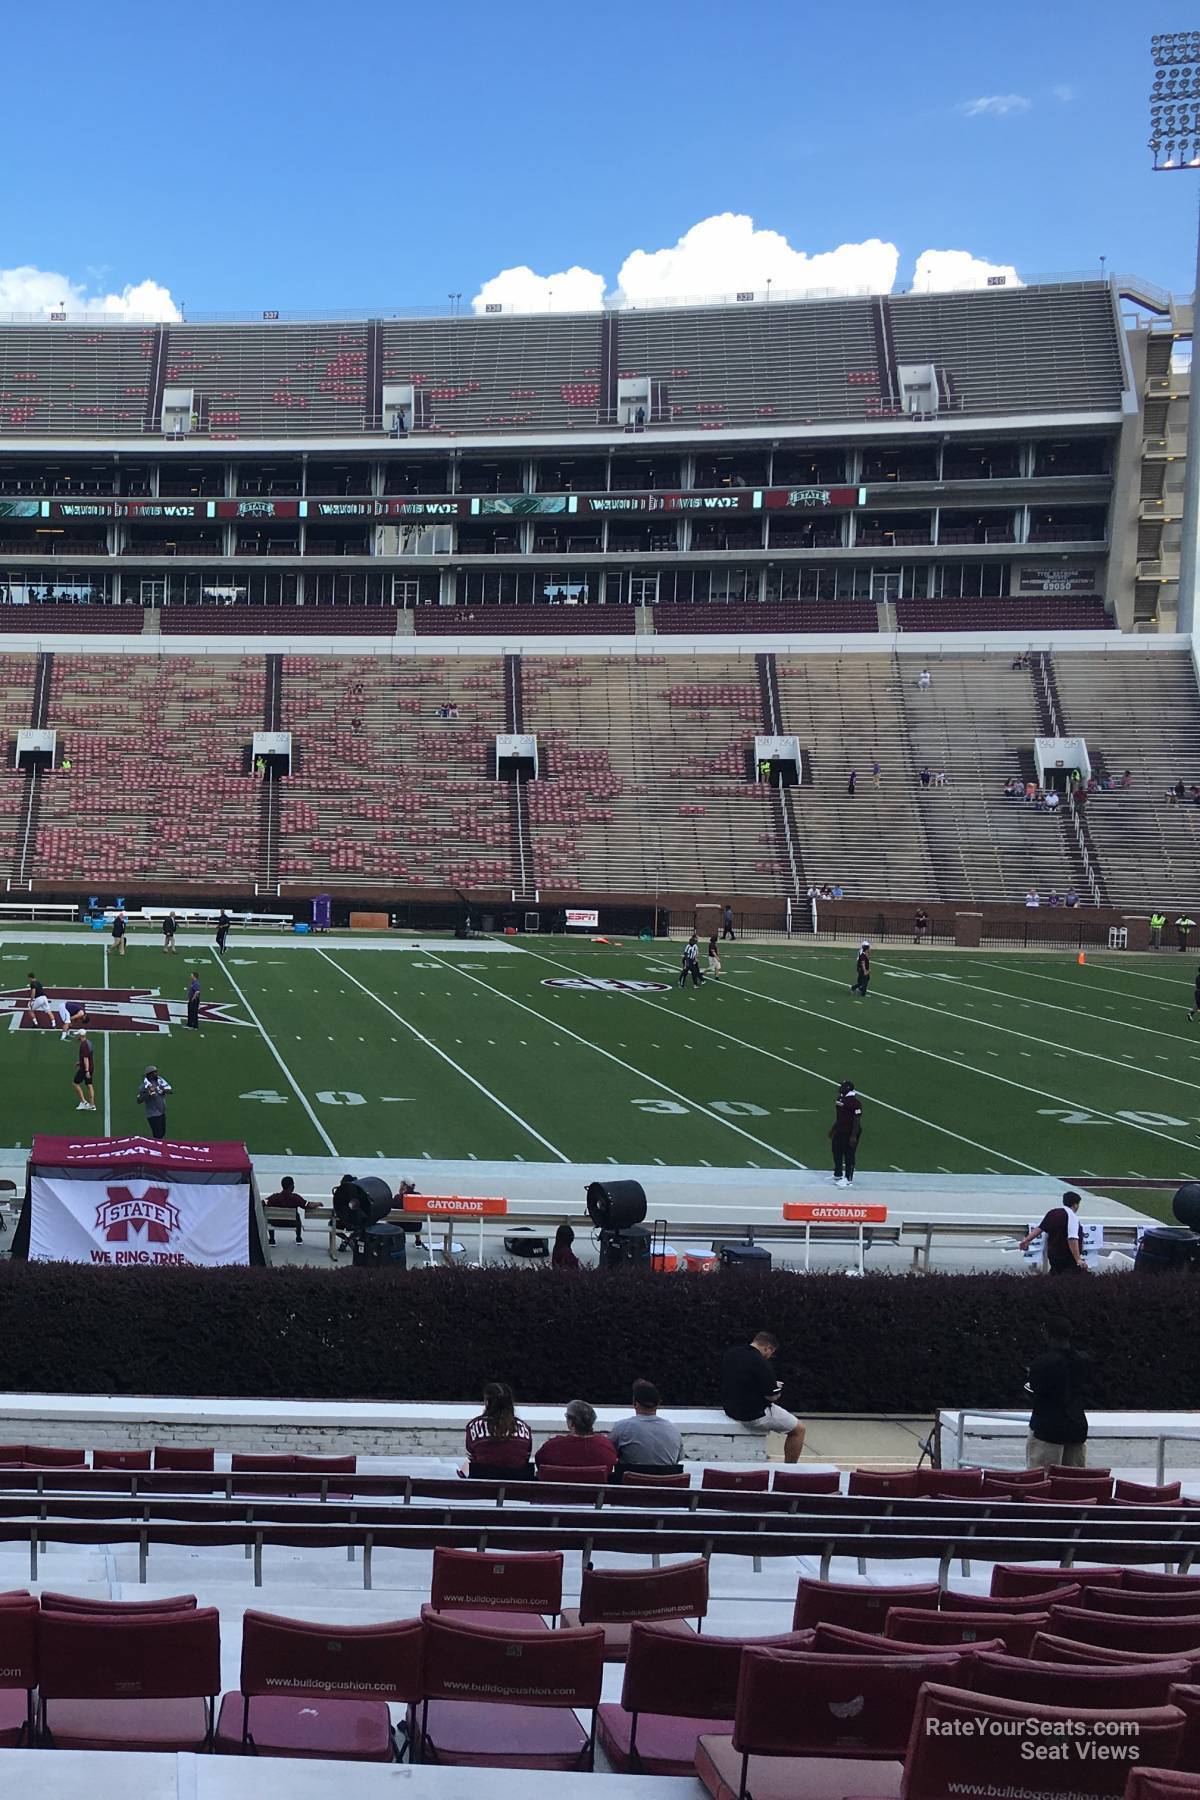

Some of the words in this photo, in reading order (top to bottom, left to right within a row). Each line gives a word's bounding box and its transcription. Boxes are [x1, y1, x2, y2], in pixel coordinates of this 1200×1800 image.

[110, 1200, 166, 1223] STATE
[427, 1200, 484, 1211] GATORADE
[812, 1208, 868, 1218] GATORADE
[90, 1250, 112, 1263] WE
[115, 1250, 150, 1264] RING
[265, 1676, 397, 1692] www.bulldogcushion.com
[443, 1679, 576, 1695] www.bulldogcushion.com
